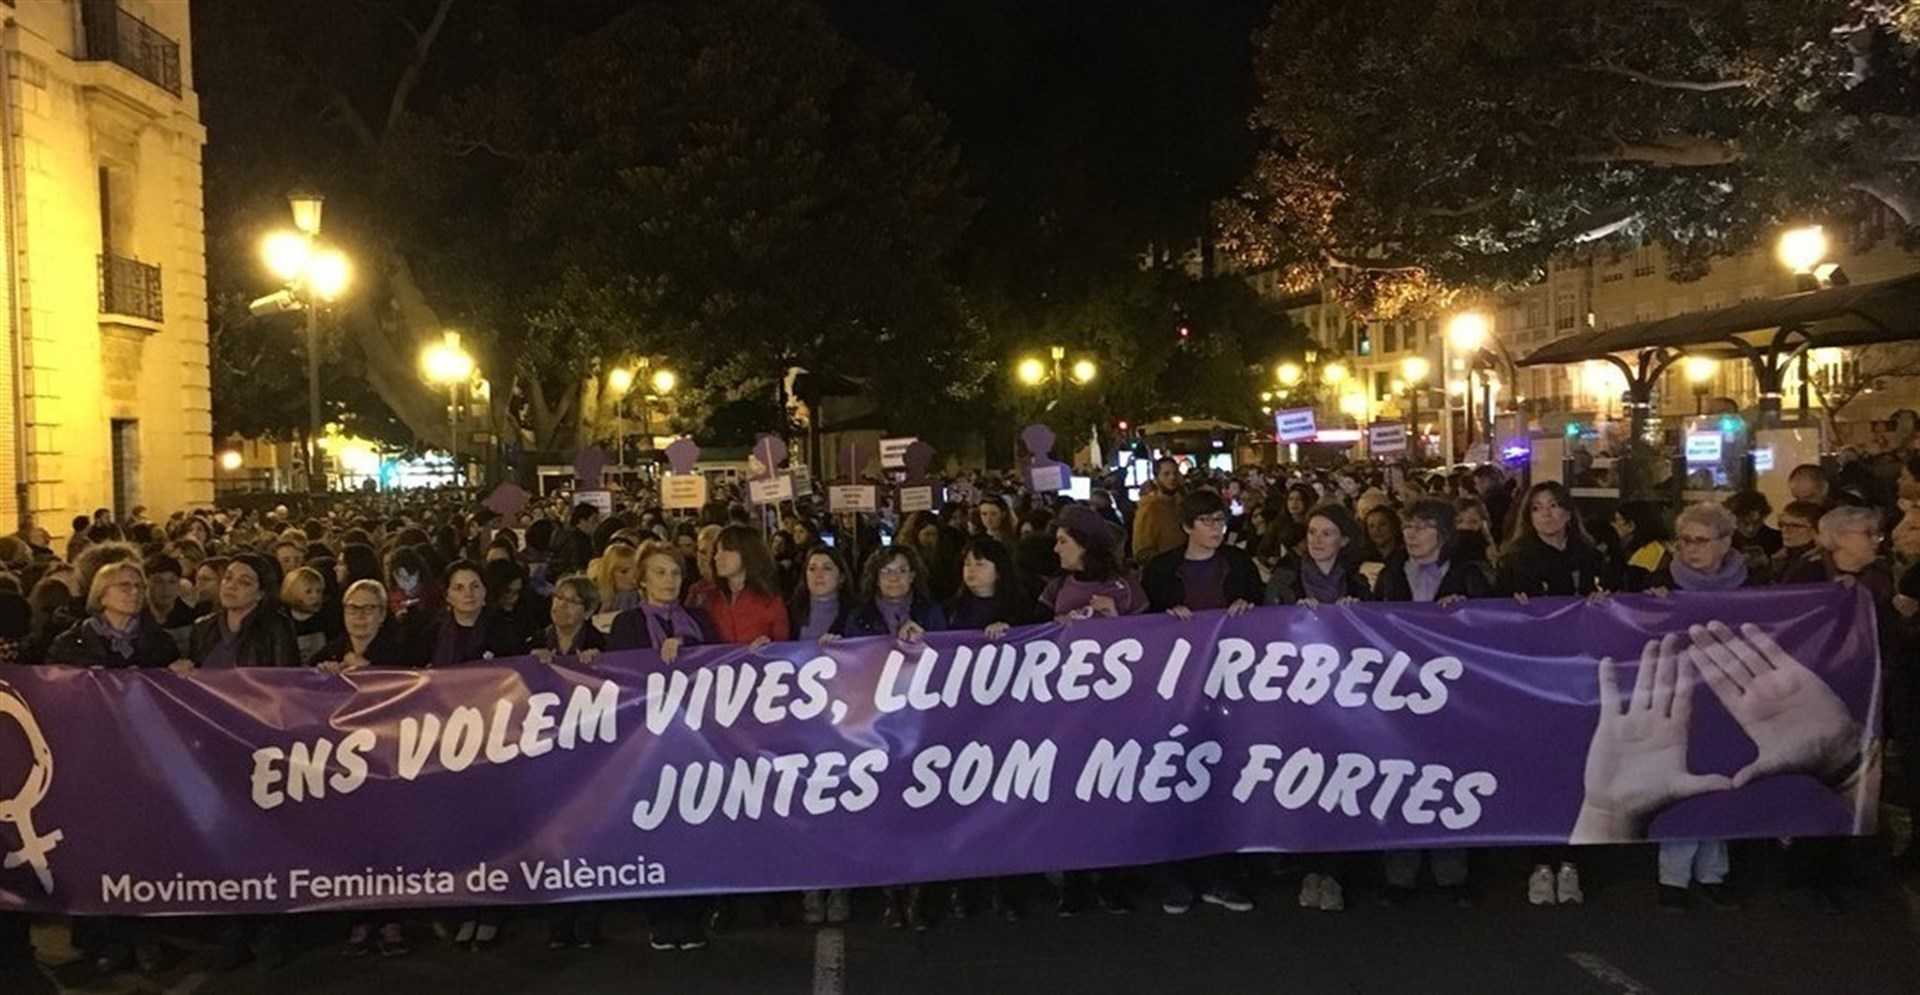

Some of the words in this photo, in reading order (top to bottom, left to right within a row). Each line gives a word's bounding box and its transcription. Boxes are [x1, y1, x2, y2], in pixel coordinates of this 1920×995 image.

[250, 729, 376, 810] ENS
[398, 680, 621, 780] VOLEM
[645, 656, 849, 736] VIVES,
[873, 638, 1143, 713] LLIURES
[1156, 638, 1191, 700] I
[1203, 638, 1463, 714] REBELS
[632, 748, 888, 830] JUNTES
[902, 739, 1058, 808] SOM
[1075, 723, 1222, 803] MÉS
[1232, 744, 1497, 830] FORTES
[101, 873, 278, 903] Moviment
[289, 867, 455, 899] Feminista
[466, 863, 509, 893] de
[520, 857, 666, 891] València
